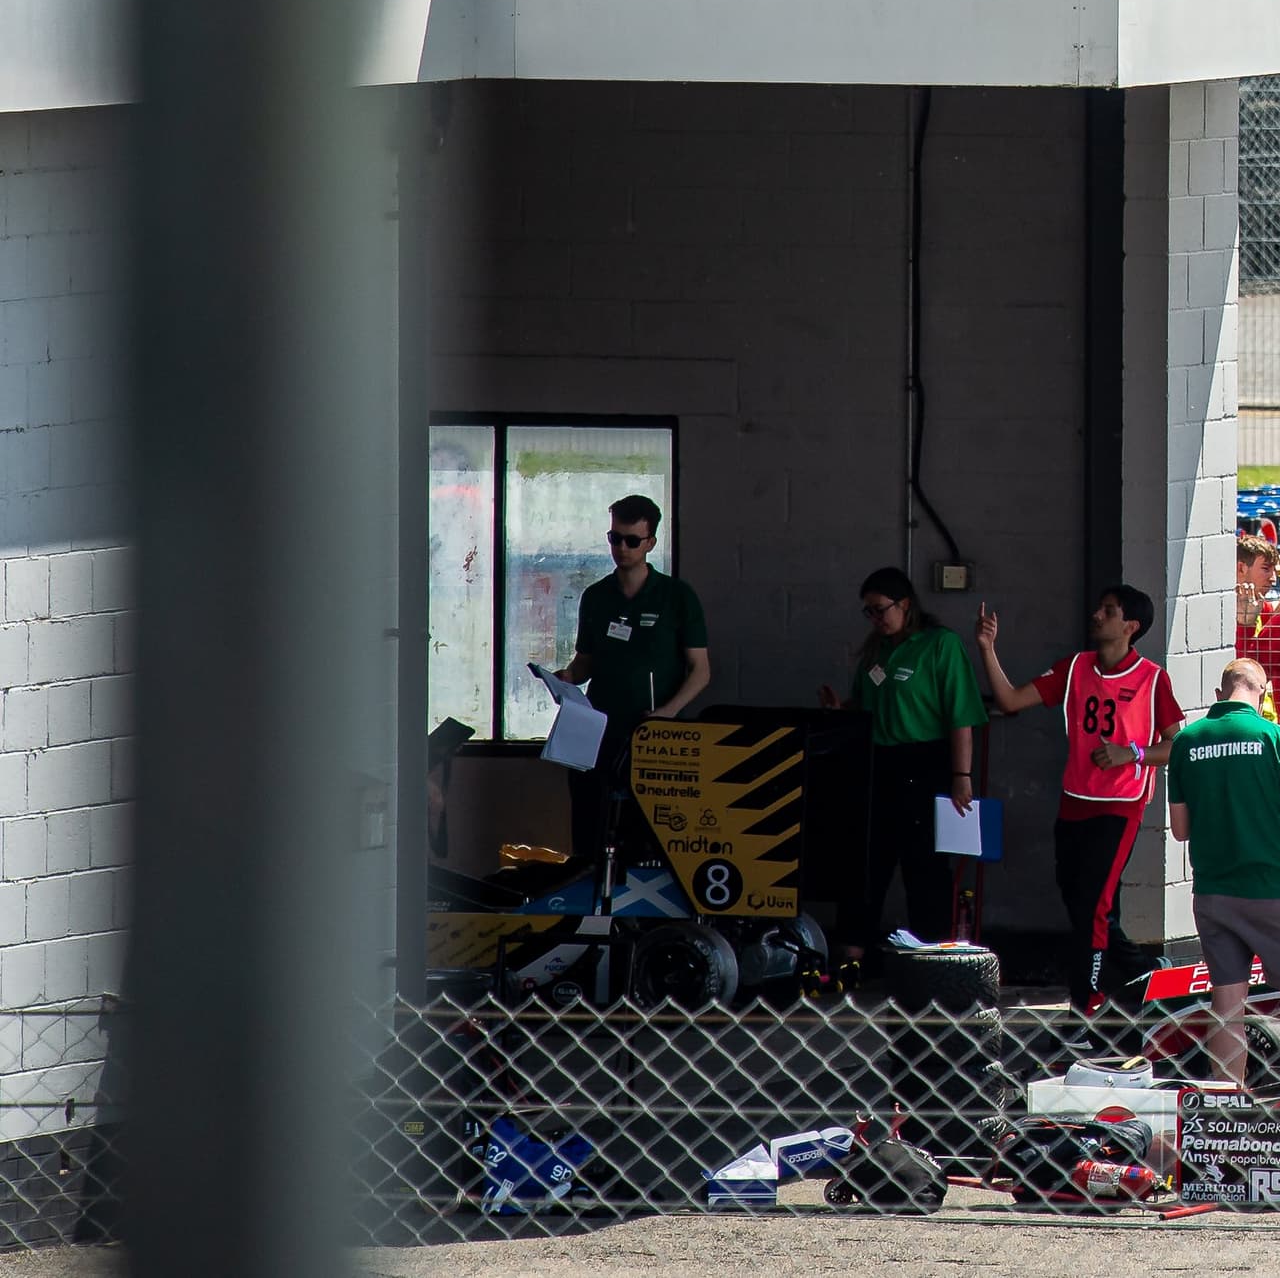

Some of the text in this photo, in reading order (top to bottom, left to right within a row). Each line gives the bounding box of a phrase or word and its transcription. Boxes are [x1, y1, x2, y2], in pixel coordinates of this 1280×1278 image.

[1083, 695, 1116, 737] 83
[651, 730, 701, 740] HOWCO
[635, 745, 701, 757] THALES
[1189, 740, 1263, 762] SCRUTINEER
[646, 784, 701, 799] neutrelle
[667, 835, 734, 855] midton
[705, 864, 730, 905] 8
[1203, 1095, 1253, 1108] SPAL
[1182, 1152, 1225, 1164] Ansys
[1182, 1183, 1246, 1193] MERITOR
